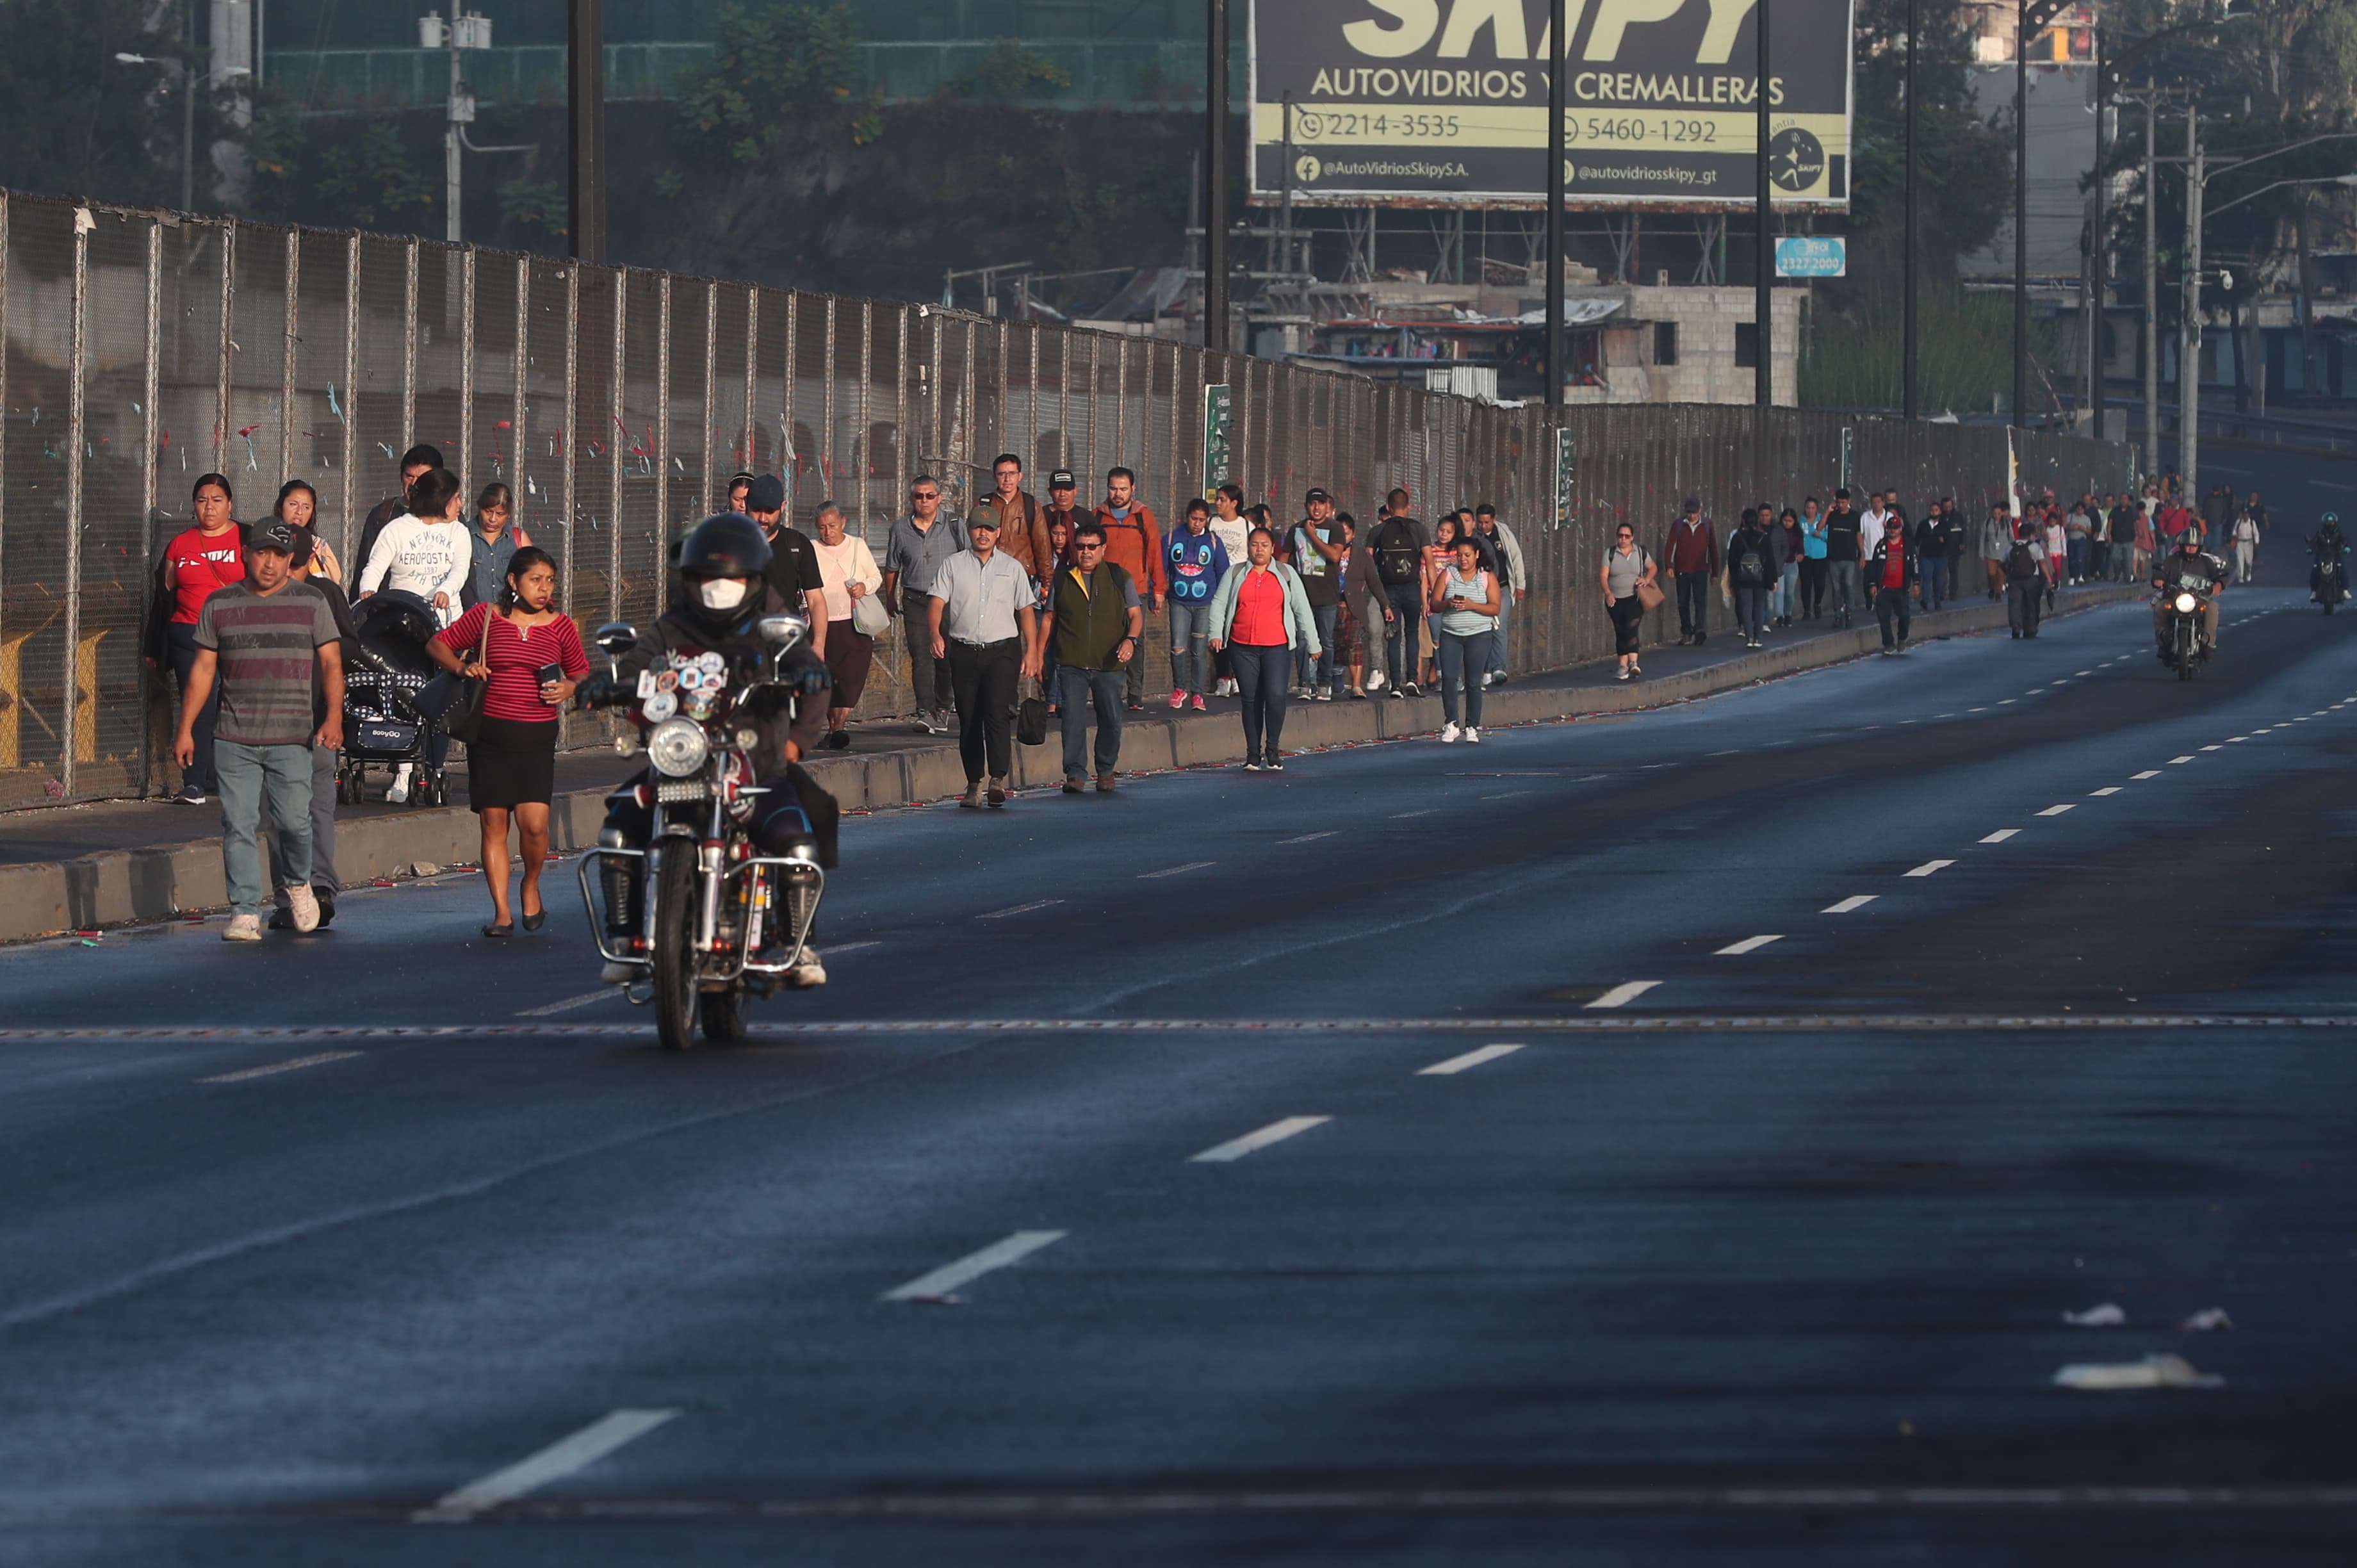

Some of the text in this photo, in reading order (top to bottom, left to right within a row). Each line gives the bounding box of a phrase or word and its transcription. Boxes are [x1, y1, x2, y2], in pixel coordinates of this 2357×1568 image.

[1311, 67, 1527, 99] AUTOVIDRIOS
[1329, 114, 1460, 136] 2214-3535
[1579, 167, 1717, 184] @autovidriosskipy_gt
[409, 530, 453, 550] NEW YORK
[398, 551, 454, 565] AEROPOSTA
